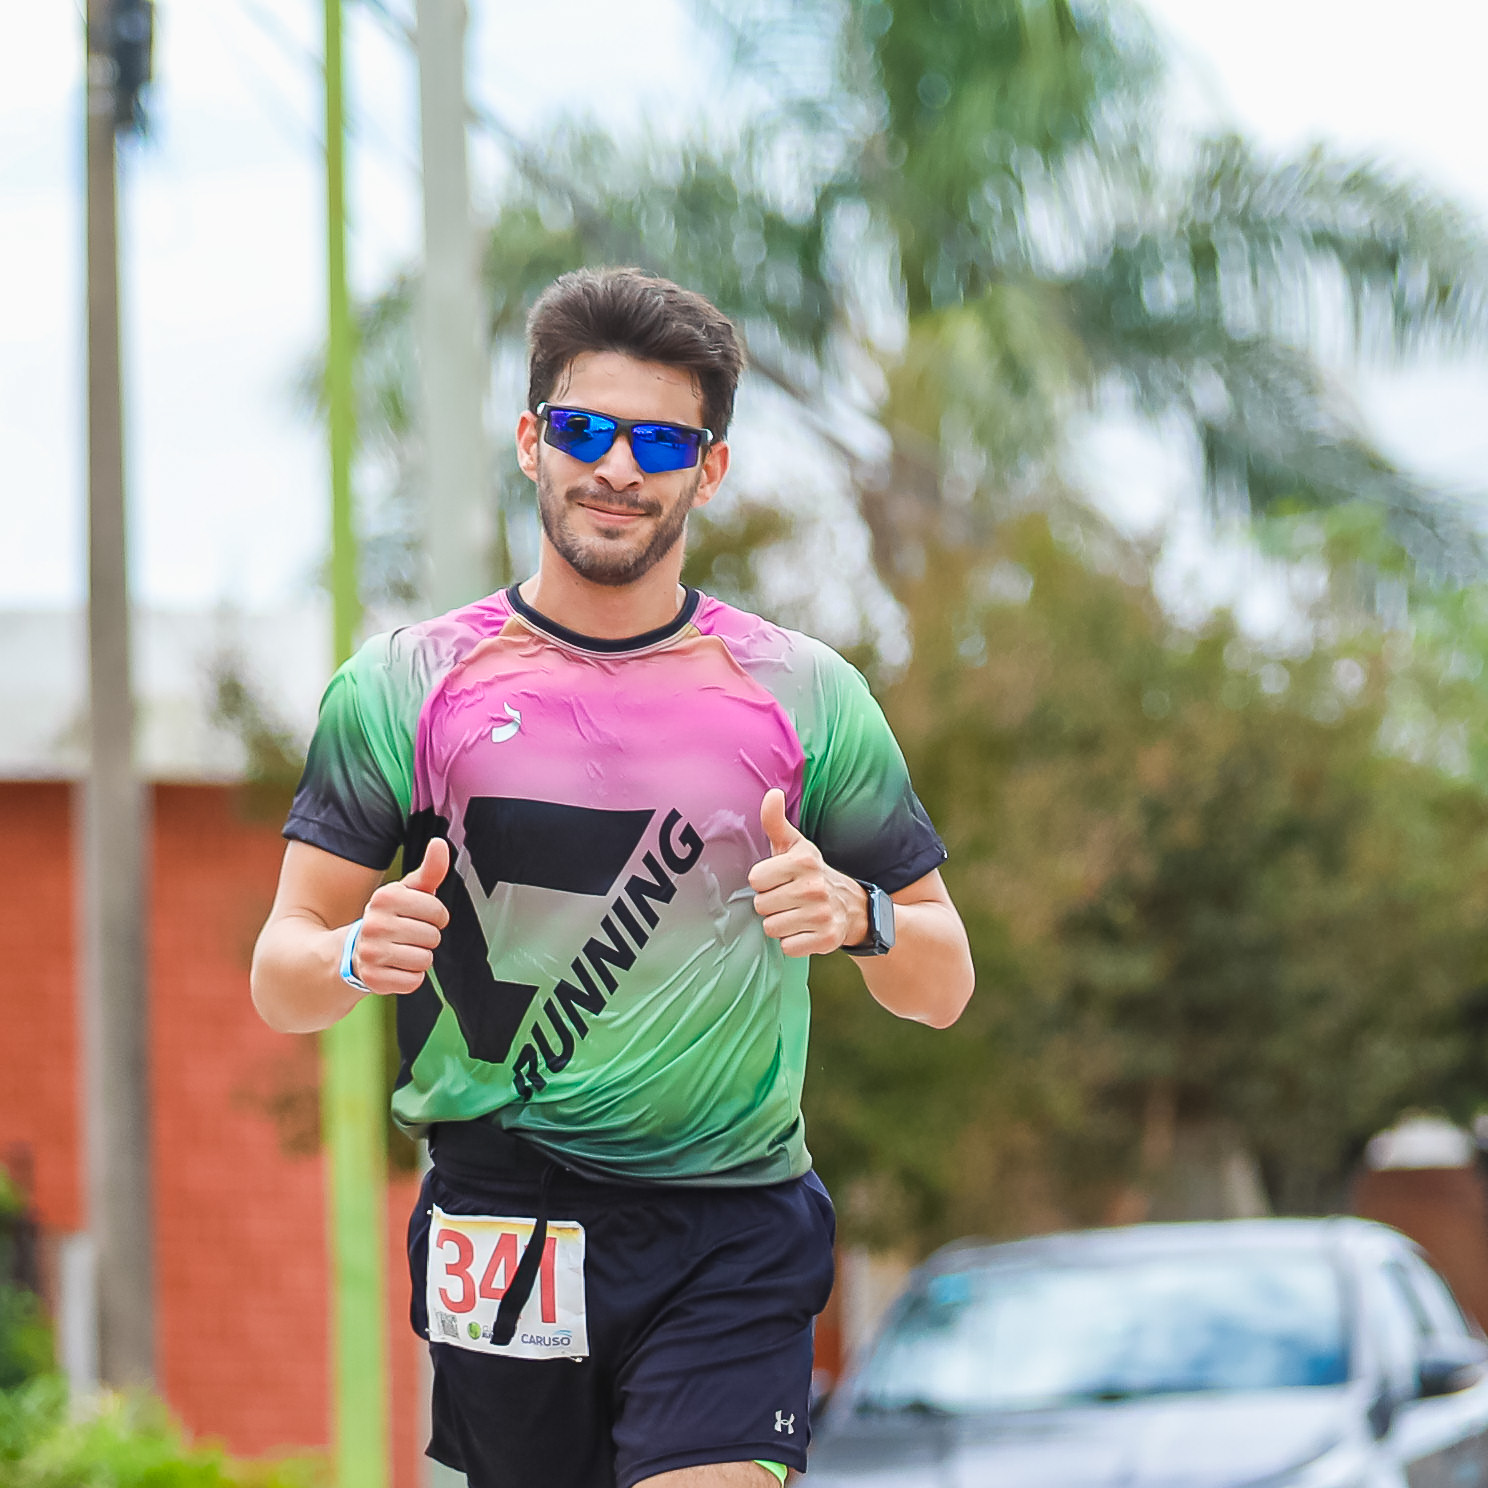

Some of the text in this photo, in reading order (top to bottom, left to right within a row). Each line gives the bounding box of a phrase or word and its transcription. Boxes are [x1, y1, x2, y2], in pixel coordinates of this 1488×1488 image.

[512, 808, 705, 1102] RUNNING
[436, 1228, 557, 1324] 341
[521, 1333, 571, 1346] CARUSO
